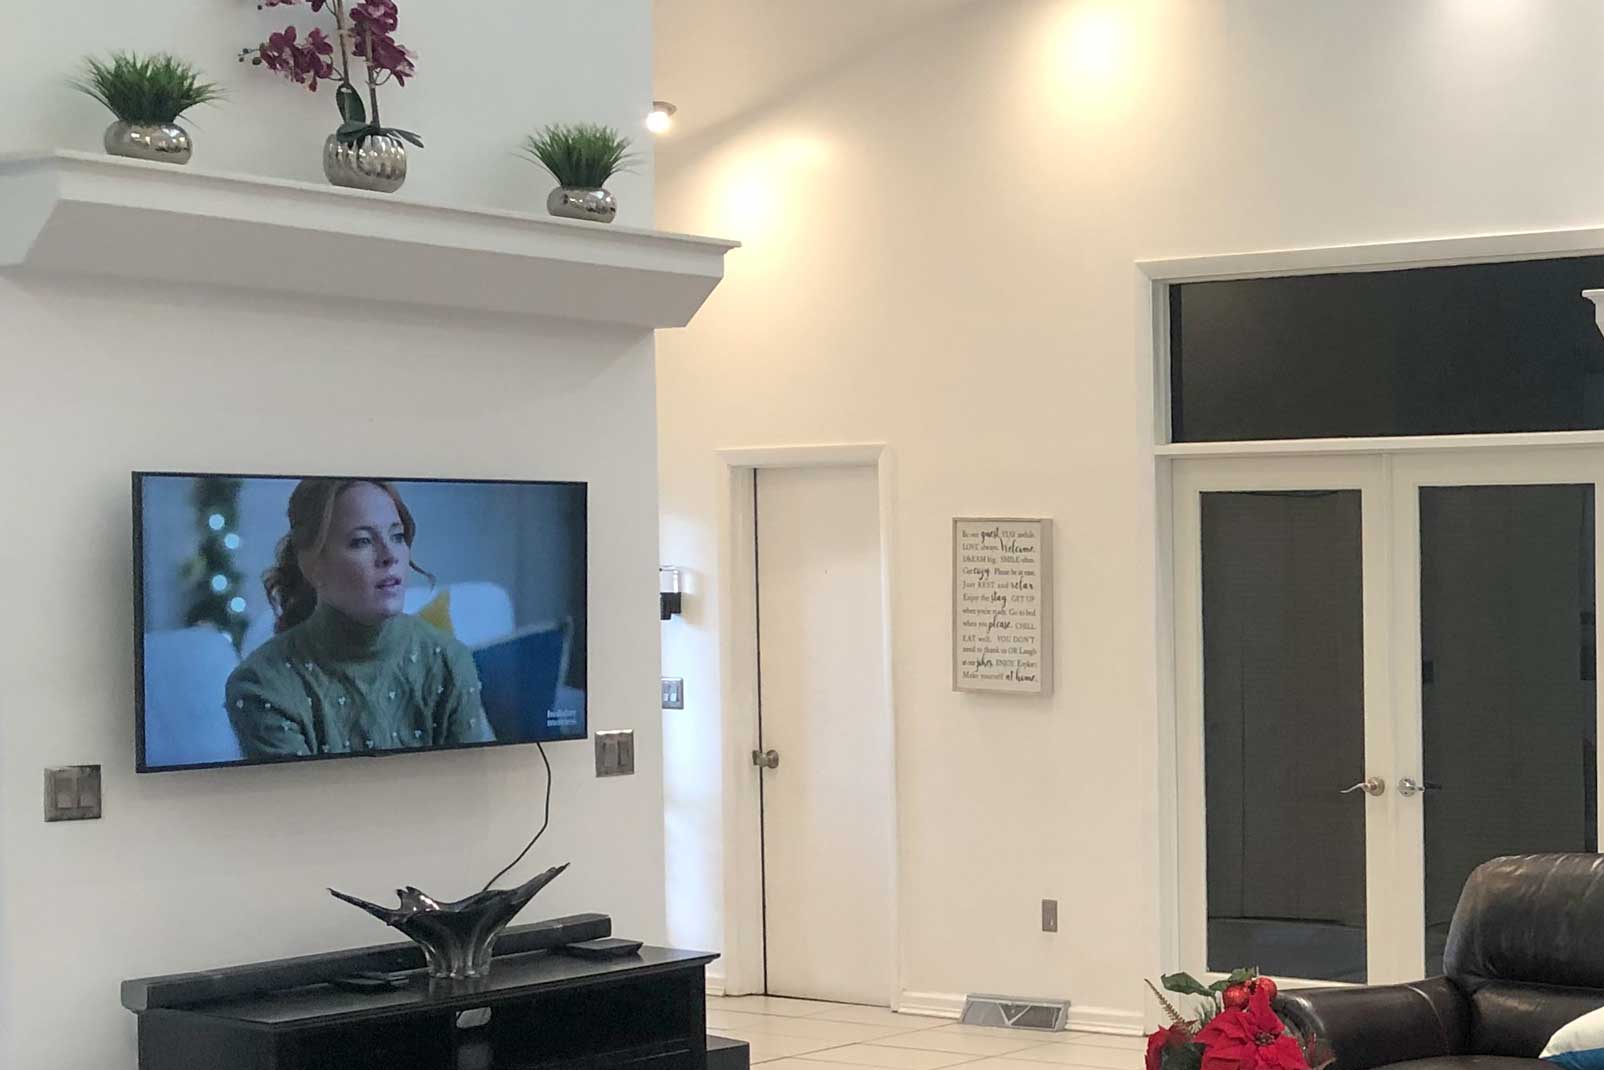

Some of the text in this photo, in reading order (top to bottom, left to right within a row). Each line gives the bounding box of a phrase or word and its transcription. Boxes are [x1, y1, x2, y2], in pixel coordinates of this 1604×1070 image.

[962, 543, 979, 551] LOVE
[977, 581, 995, 589] REST
[997, 581, 1009, 589] and
[962, 634, 976, 642] EAT
[1008, 646, 1018, 654] OR
